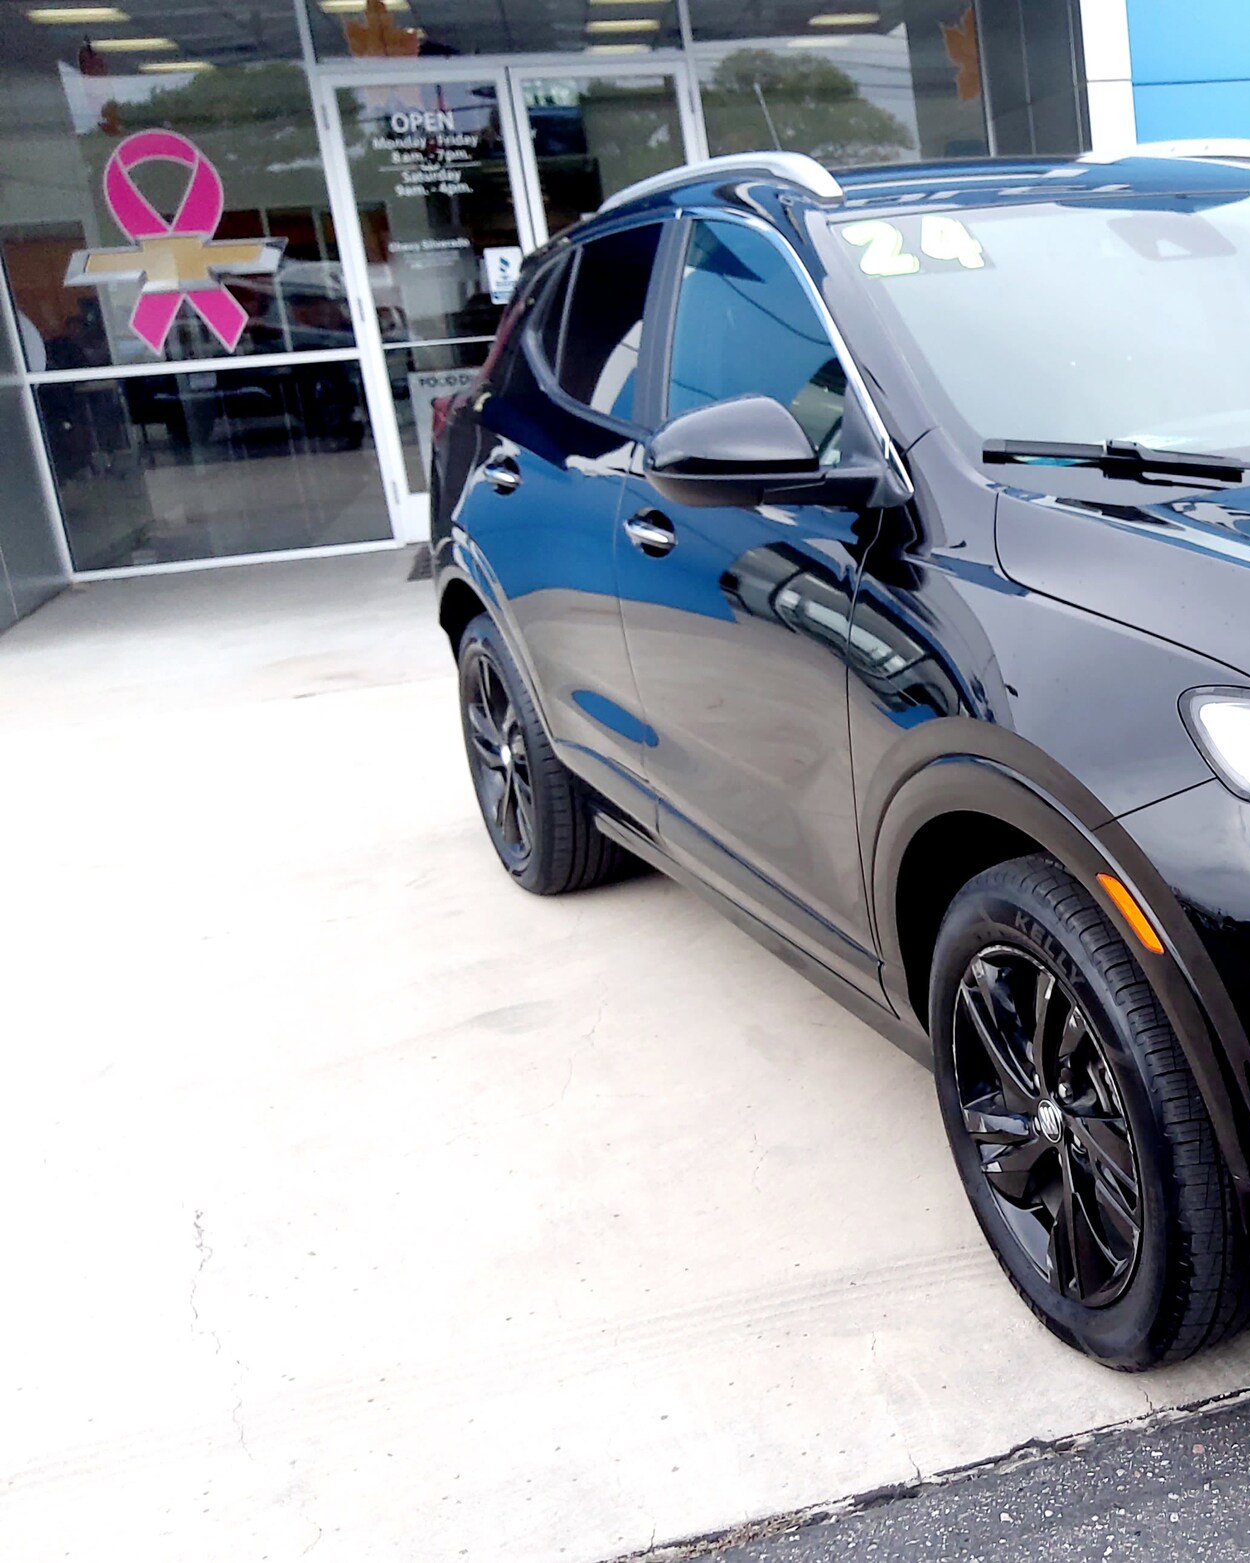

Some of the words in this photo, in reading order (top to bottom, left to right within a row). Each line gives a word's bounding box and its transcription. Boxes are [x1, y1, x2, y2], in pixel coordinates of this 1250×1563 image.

[391, 111, 454, 133] OPEN
[372, 135, 427, 150] Monday
[436, 133, 478, 148] Friday
[401, 170, 461, 183] Saturday
[841, 216, 985, 277] 24
[1015, 910, 1086, 985] KELLY
